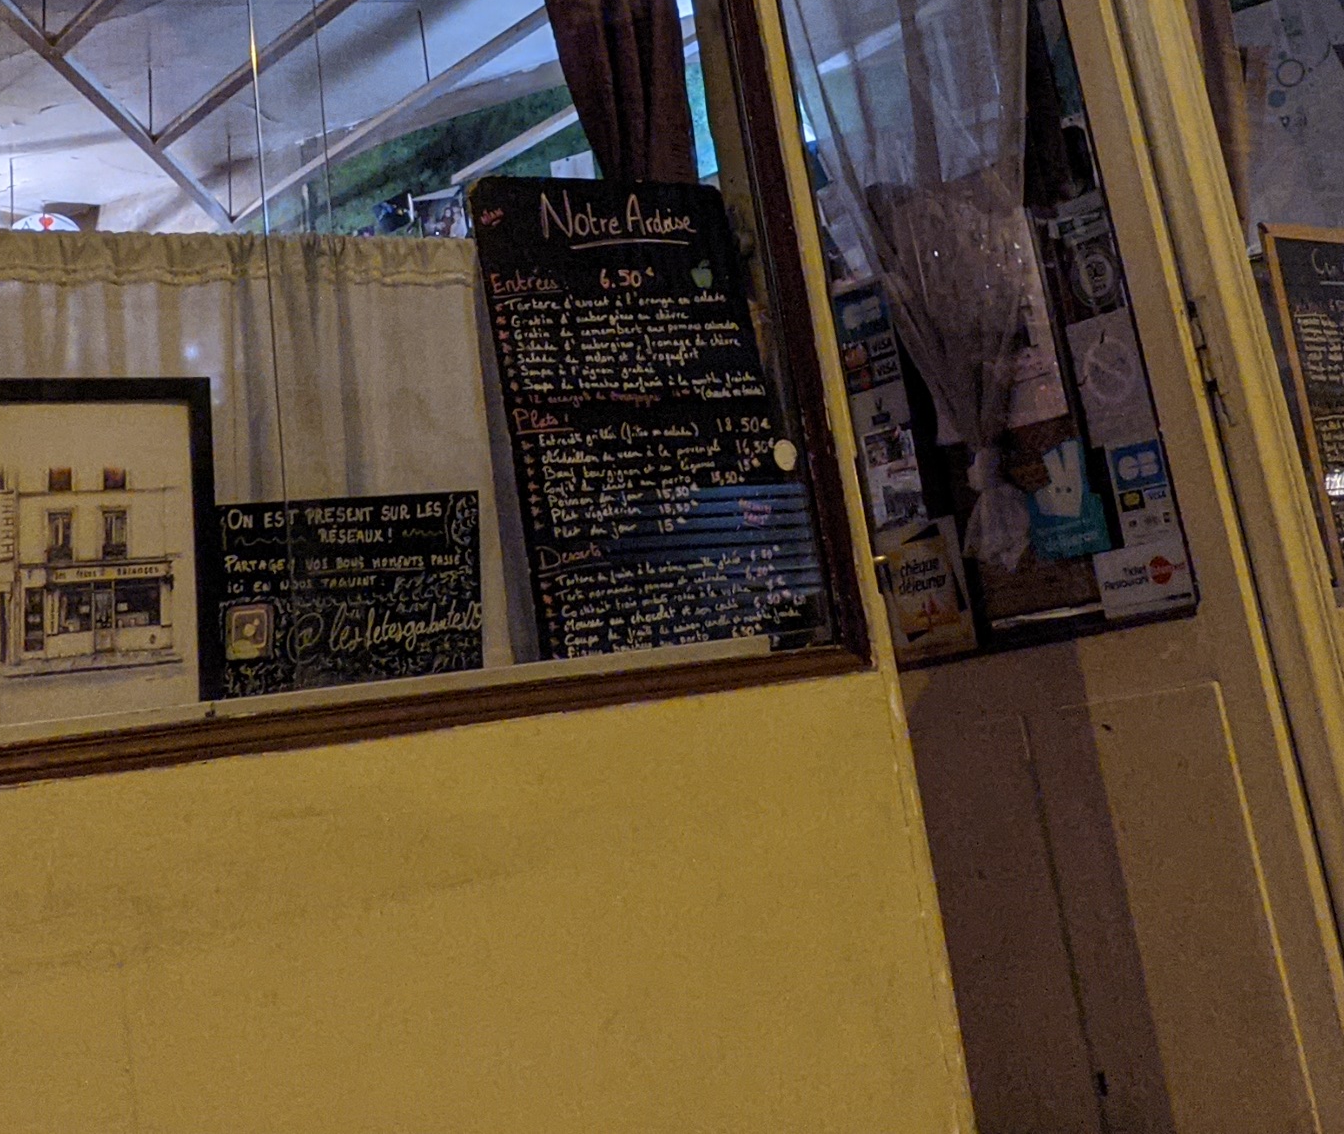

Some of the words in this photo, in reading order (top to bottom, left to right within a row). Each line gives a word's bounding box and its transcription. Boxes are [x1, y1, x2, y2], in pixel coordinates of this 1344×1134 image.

[540, 189, 621, 240] Notre
[626, 192, 697, 237] Ardoise
[264, 511, 296, 529] EST
[381, 504, 411, 522] SUR
[416, 501, 443, 519] LES
[372, 555, 425, 570] MOMENTS
[900, 557, 940, 577] chèque
[898, 574, 947, 596] déjeuner
